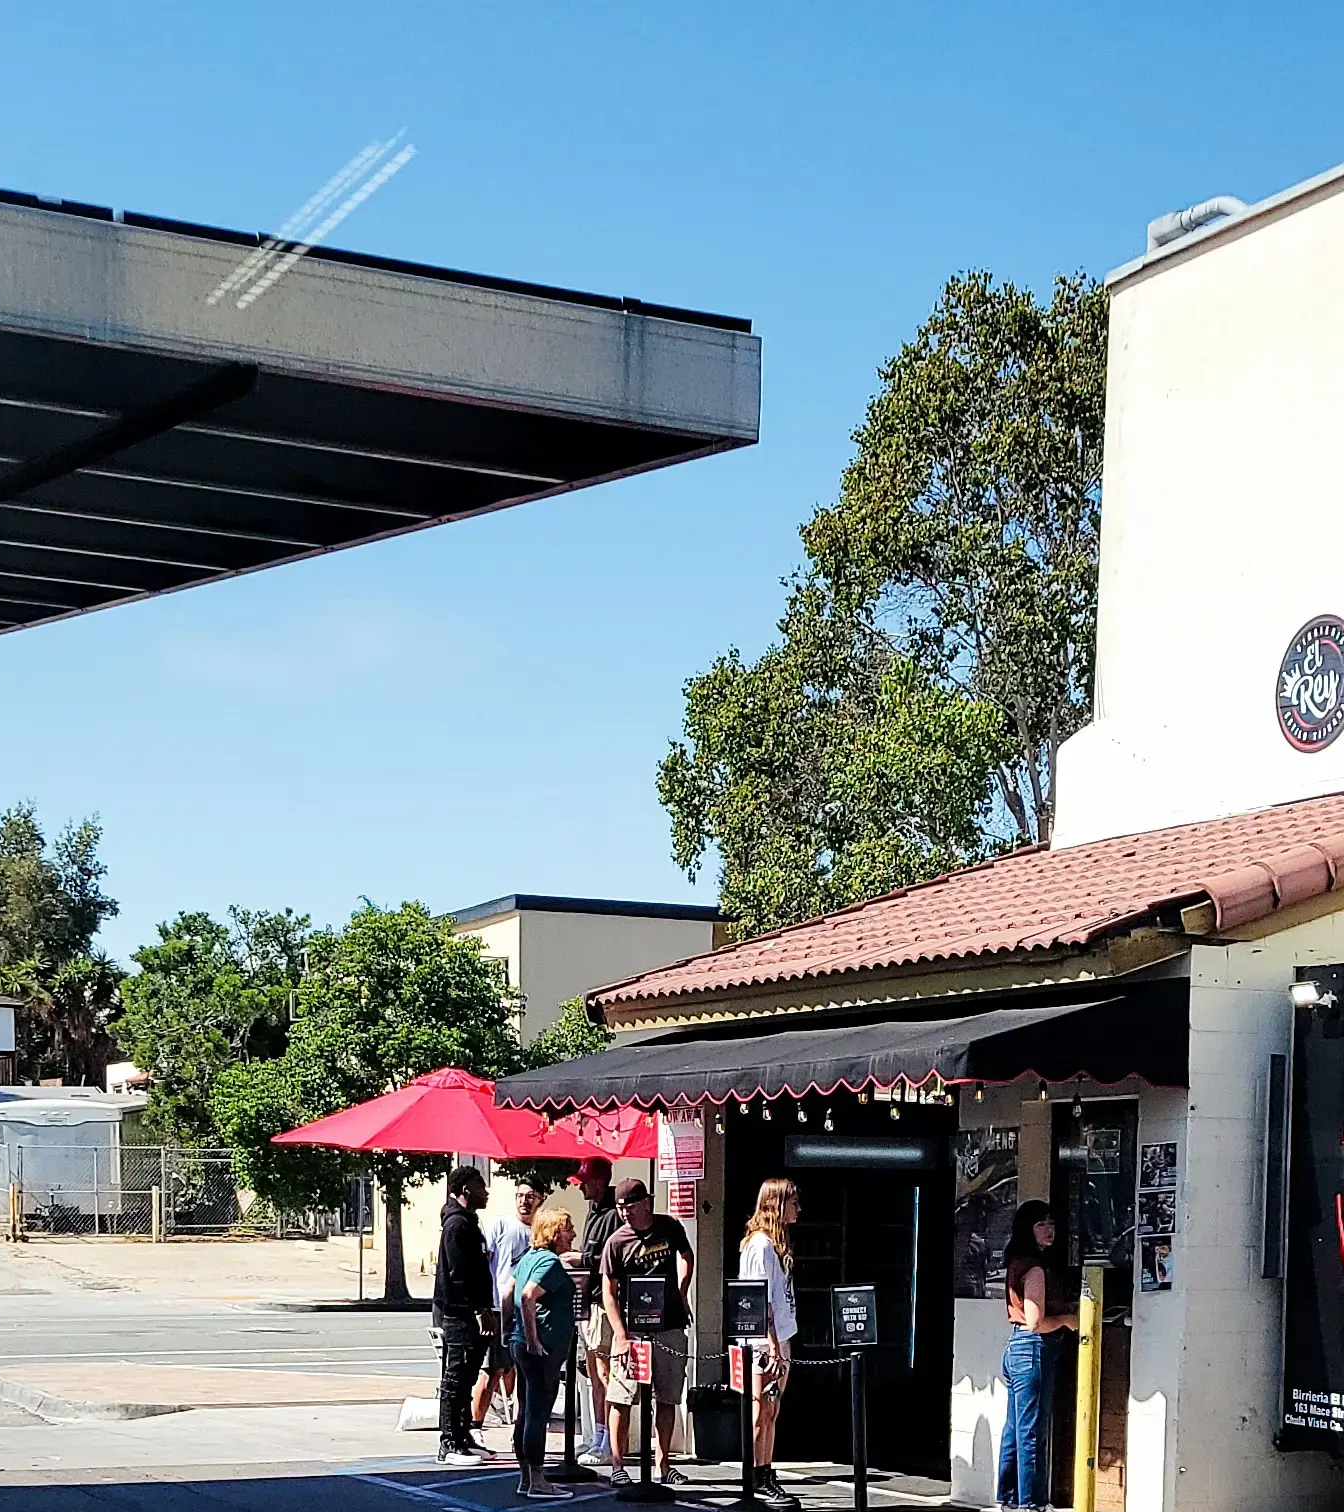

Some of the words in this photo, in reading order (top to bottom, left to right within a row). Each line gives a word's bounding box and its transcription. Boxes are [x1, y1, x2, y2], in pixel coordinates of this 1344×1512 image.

[1303, 639, 1323, 675] El
[1291, 669, 1340, 719] Rey
[1292, 1388, 1329, 1404] Birrieria
[1330, 1392, 1341, 1406] El
[1284, 1413, 1306, 1426] Chula
[1307, 1416, 1328, 1430] Vista
